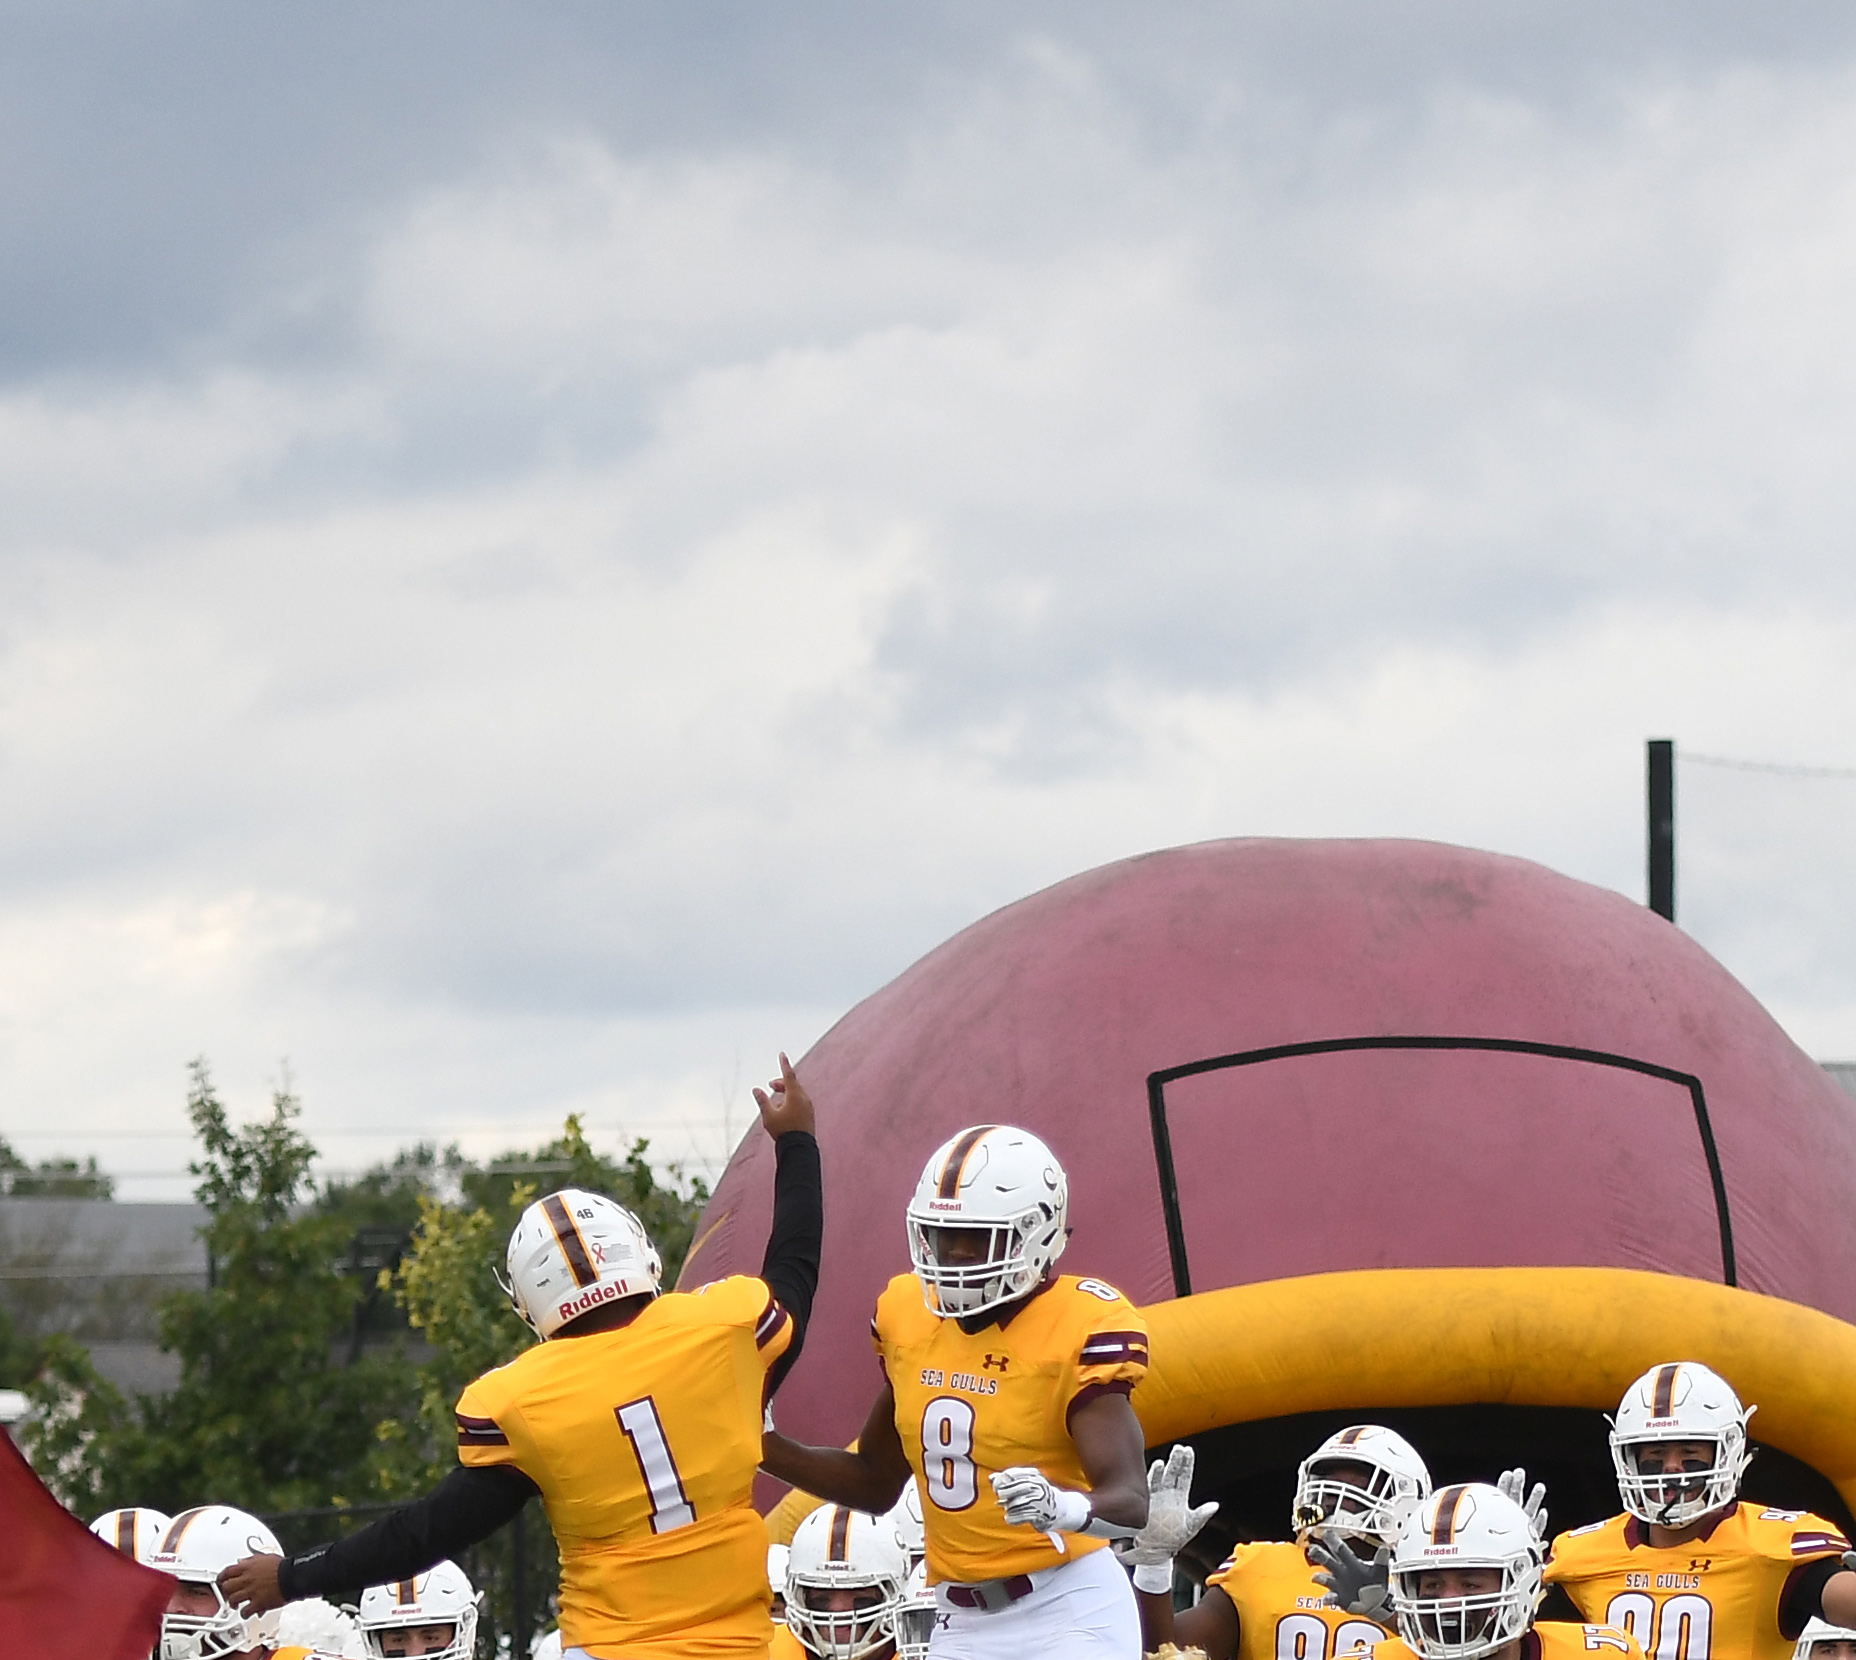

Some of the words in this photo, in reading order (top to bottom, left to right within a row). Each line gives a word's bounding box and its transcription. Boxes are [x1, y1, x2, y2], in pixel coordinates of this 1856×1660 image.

[576, 1208, 594, 1220] 46
[928, 1201, 962, 1212] Riddell
[558, 1279, 629, 1320] Riddell
[920, 1369, 944, 1387] SEA
[950, 1373, 997, 1395] GULLS
[921, 1395, 980, 1513] 8
[614, 1394, 698, 1536] 1
[1424, 1547, 1458, 1556] Riddell
[1626, 1573, 1649, 1588] SEA
[1656, 1573, 1700, 1589] GULLS
[915, 1590, 934, 1599] Ridd
